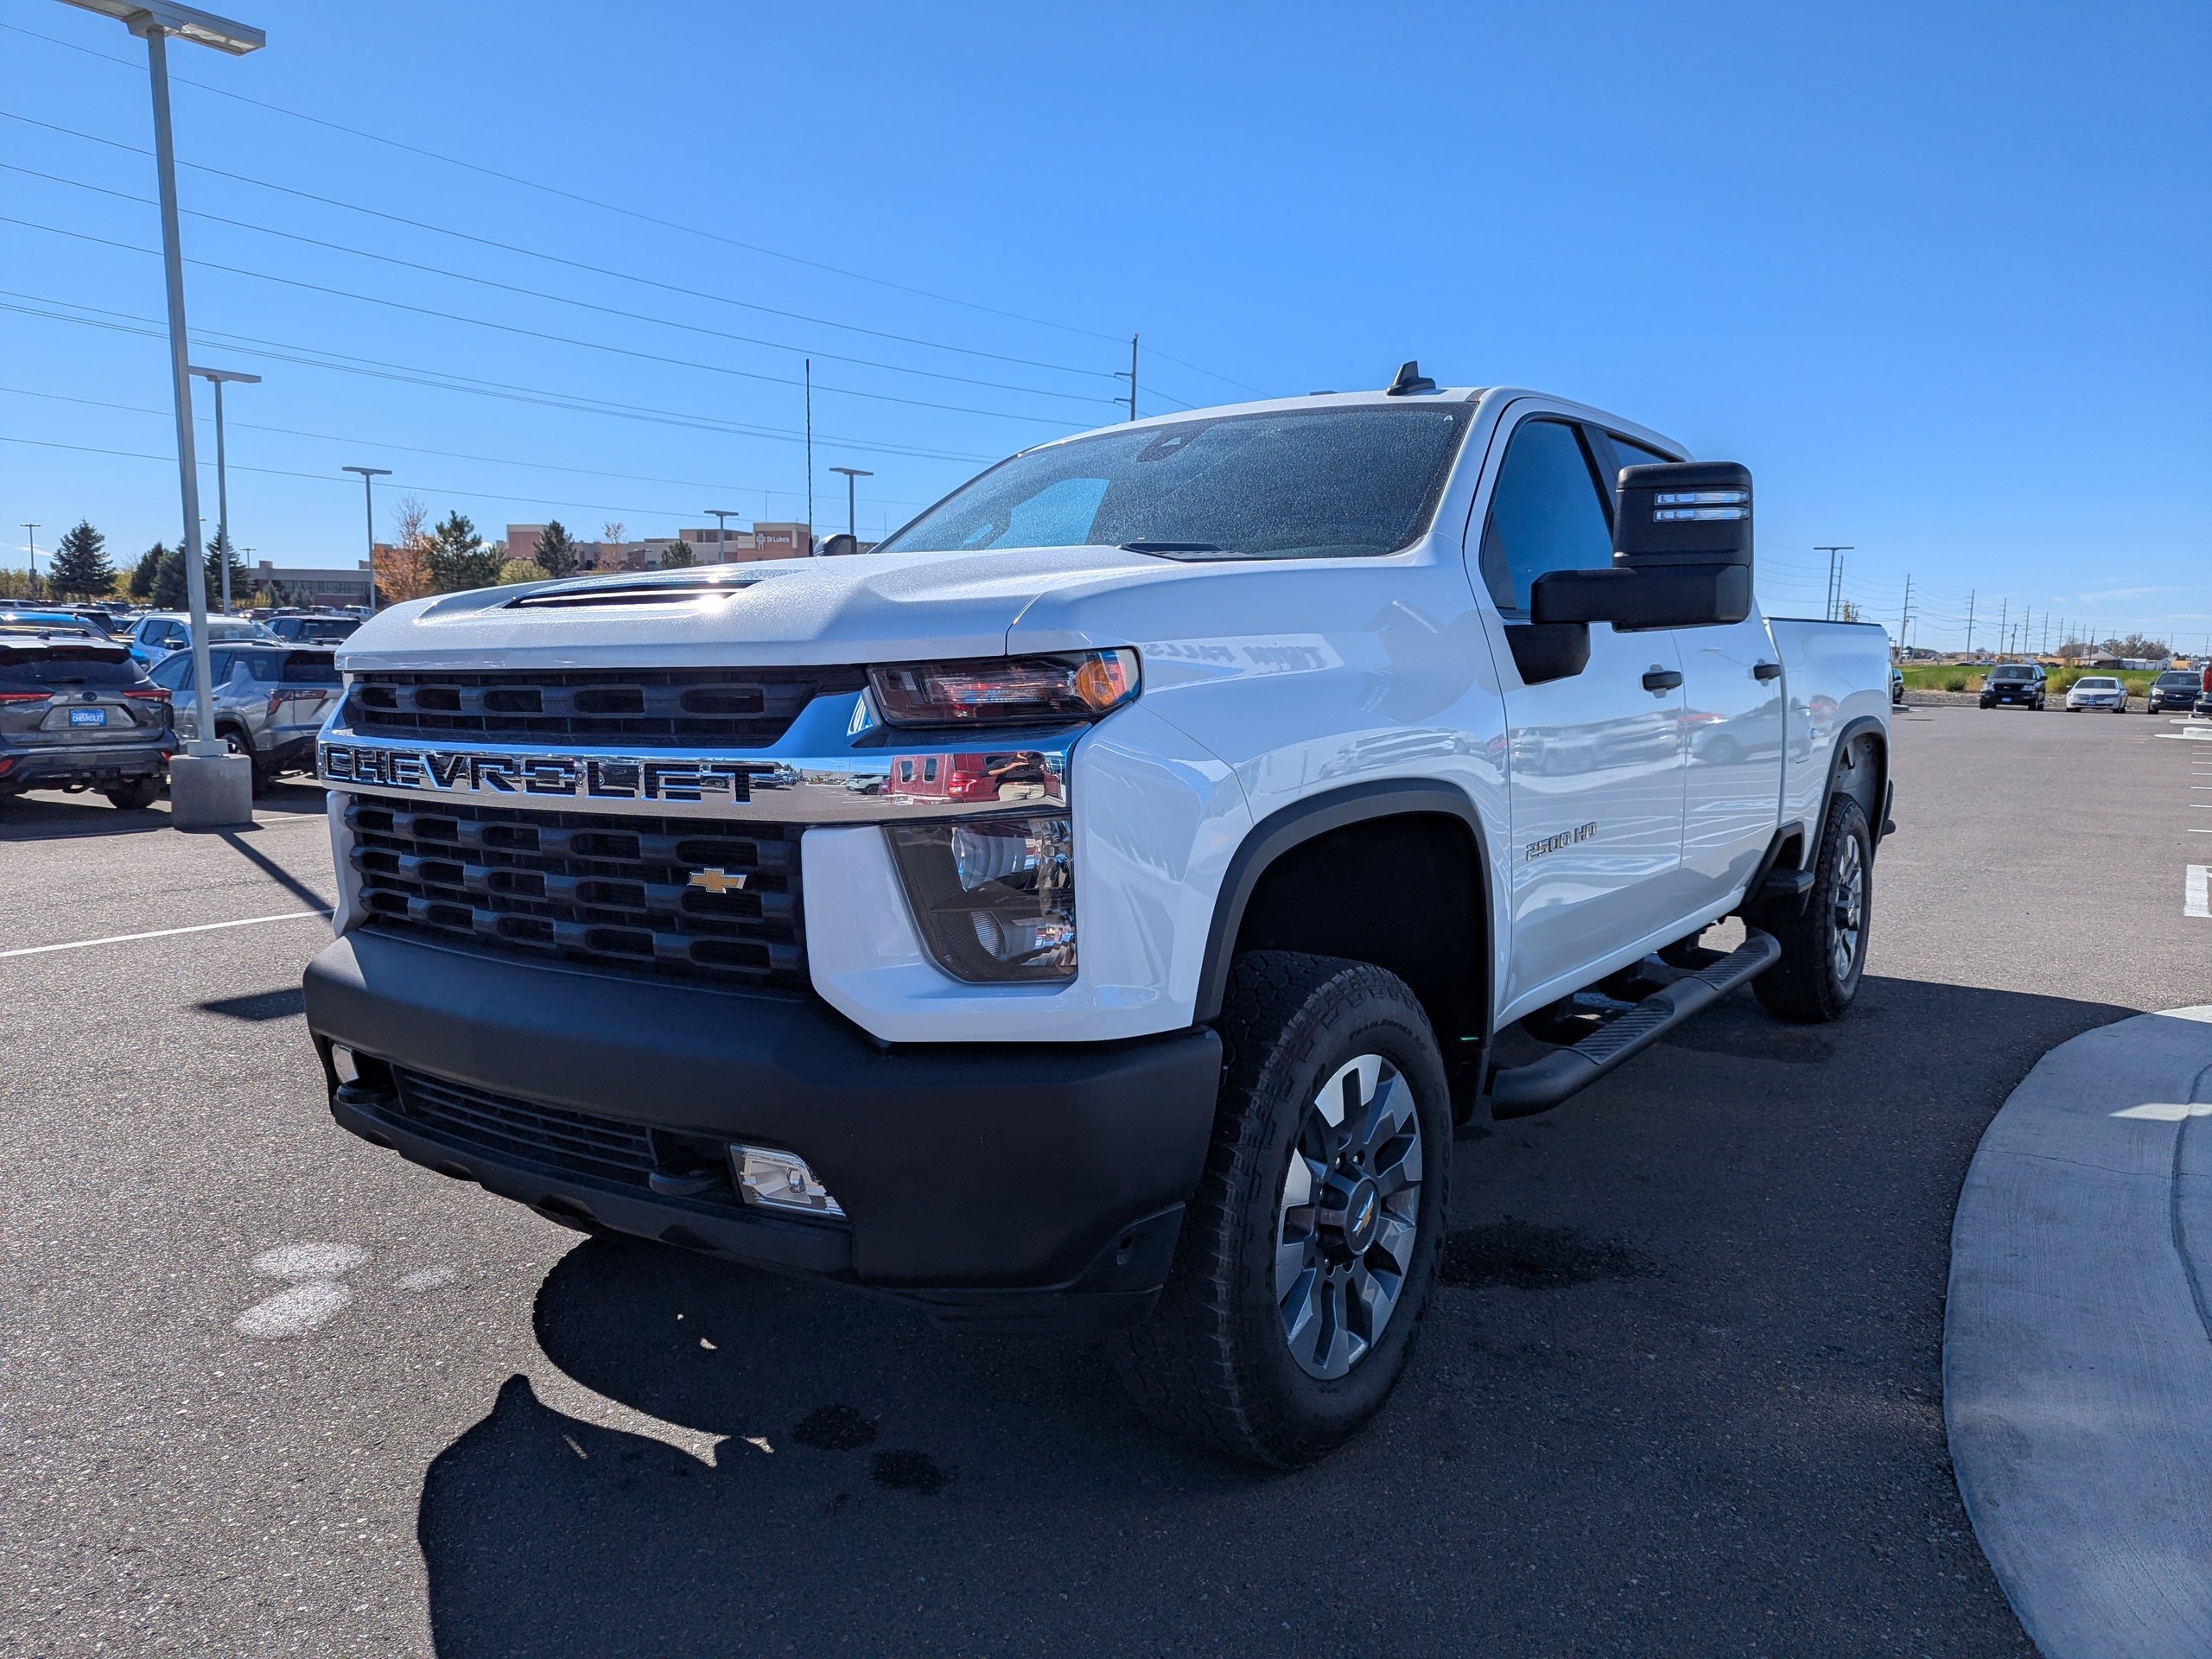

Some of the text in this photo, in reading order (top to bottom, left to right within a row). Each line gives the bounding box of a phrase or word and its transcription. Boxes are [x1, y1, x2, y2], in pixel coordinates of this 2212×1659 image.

[323, 744, 779, 805] CHEVROLET
[1525, 821, 1598, 861] 2500 HD
